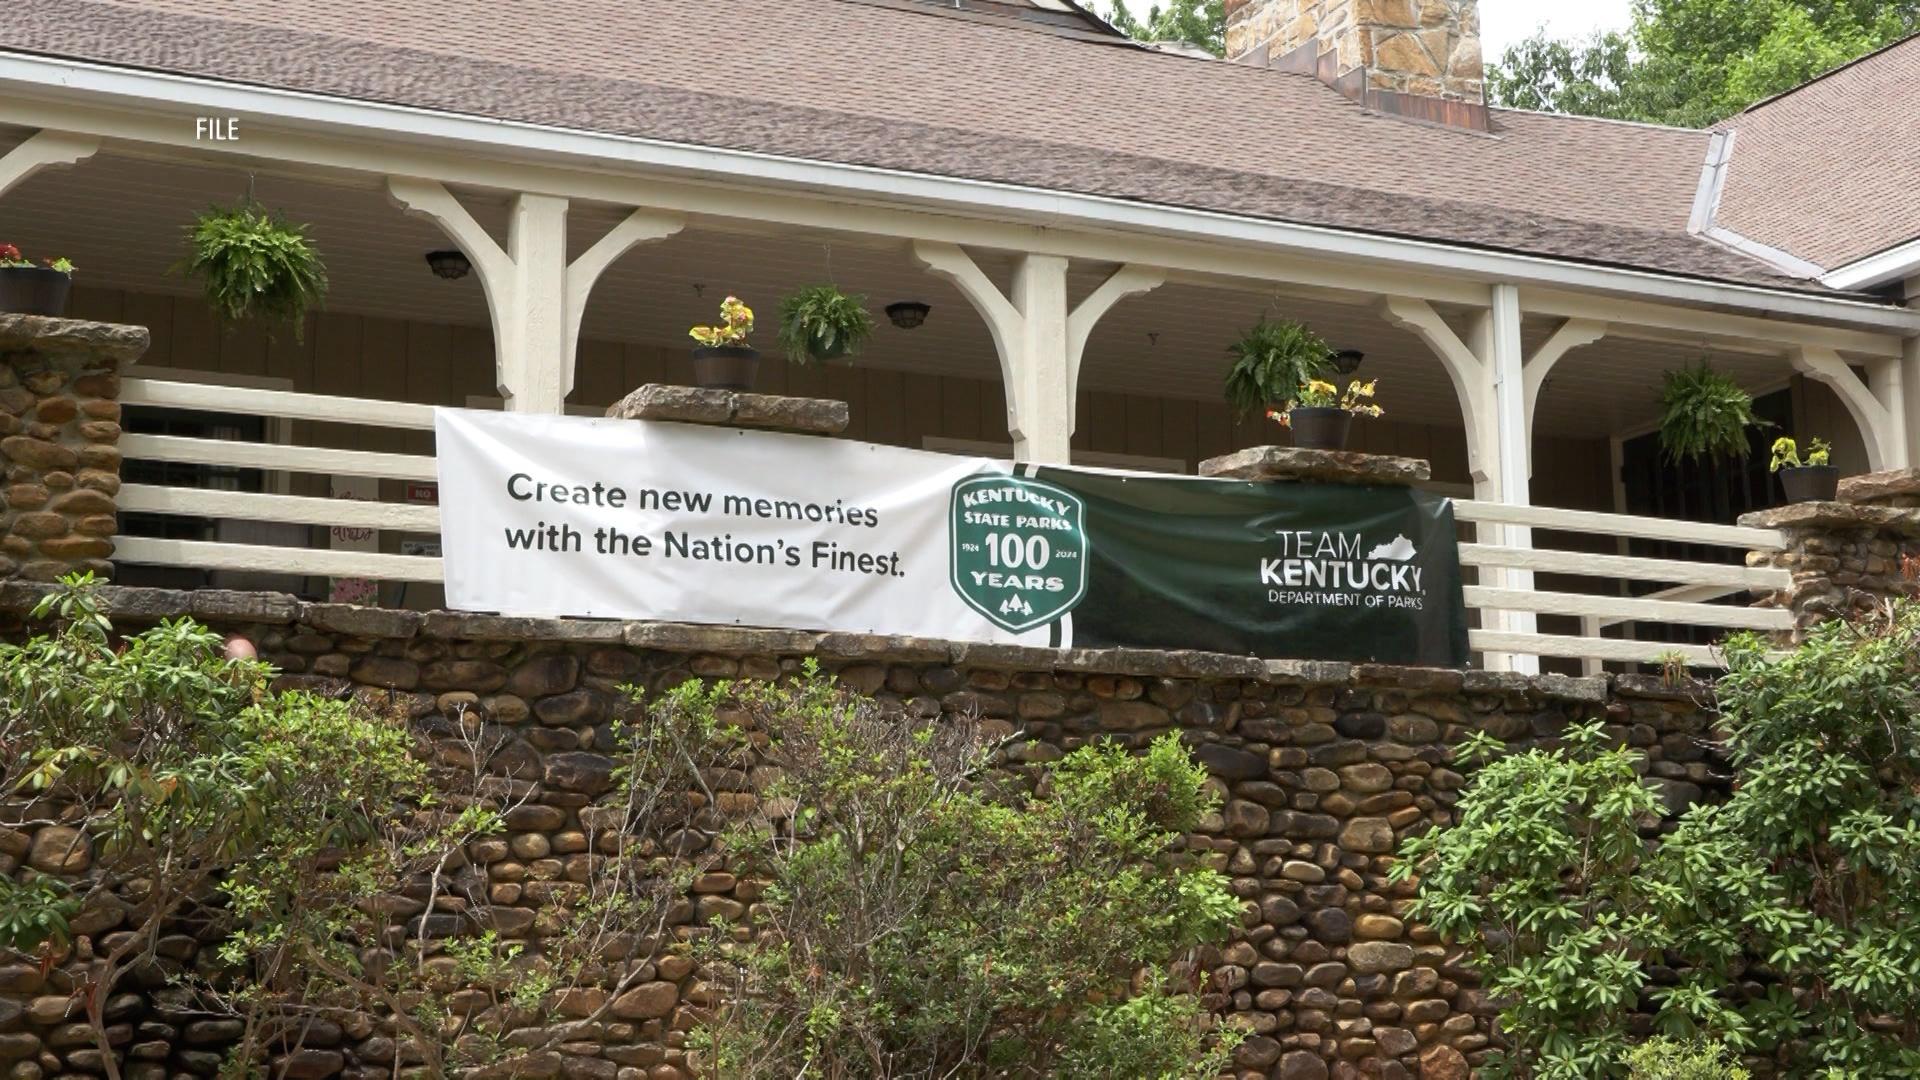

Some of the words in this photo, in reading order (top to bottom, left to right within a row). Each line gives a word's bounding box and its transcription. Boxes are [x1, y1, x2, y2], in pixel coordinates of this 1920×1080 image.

[507, 472, 627, 509] Create
[639, 487, 713, 513] new
[723, 494, 878, 528] memories
[962, 487, 1071, 516] KENTUCKY
[964, 511, 1010, 527] STATE
[1016, 515, 1072, 531] PARKS
[505, 521, 582, 553] with
[594, 527, 652, 556] the
[664, 531, 801, 567] Nation's
[812, 541, 906, 578] Finest.
[985, 532, 1050, 570] 100
[1275, 530, 1361, 560] TEAM
[970, 571, 1065, 592] YEARS
[1268, 589, 1361, 606] DEPARTMENT
[1365, 595, 1384, 608] OF
[1388, 595, 1423, 610] PARKS
